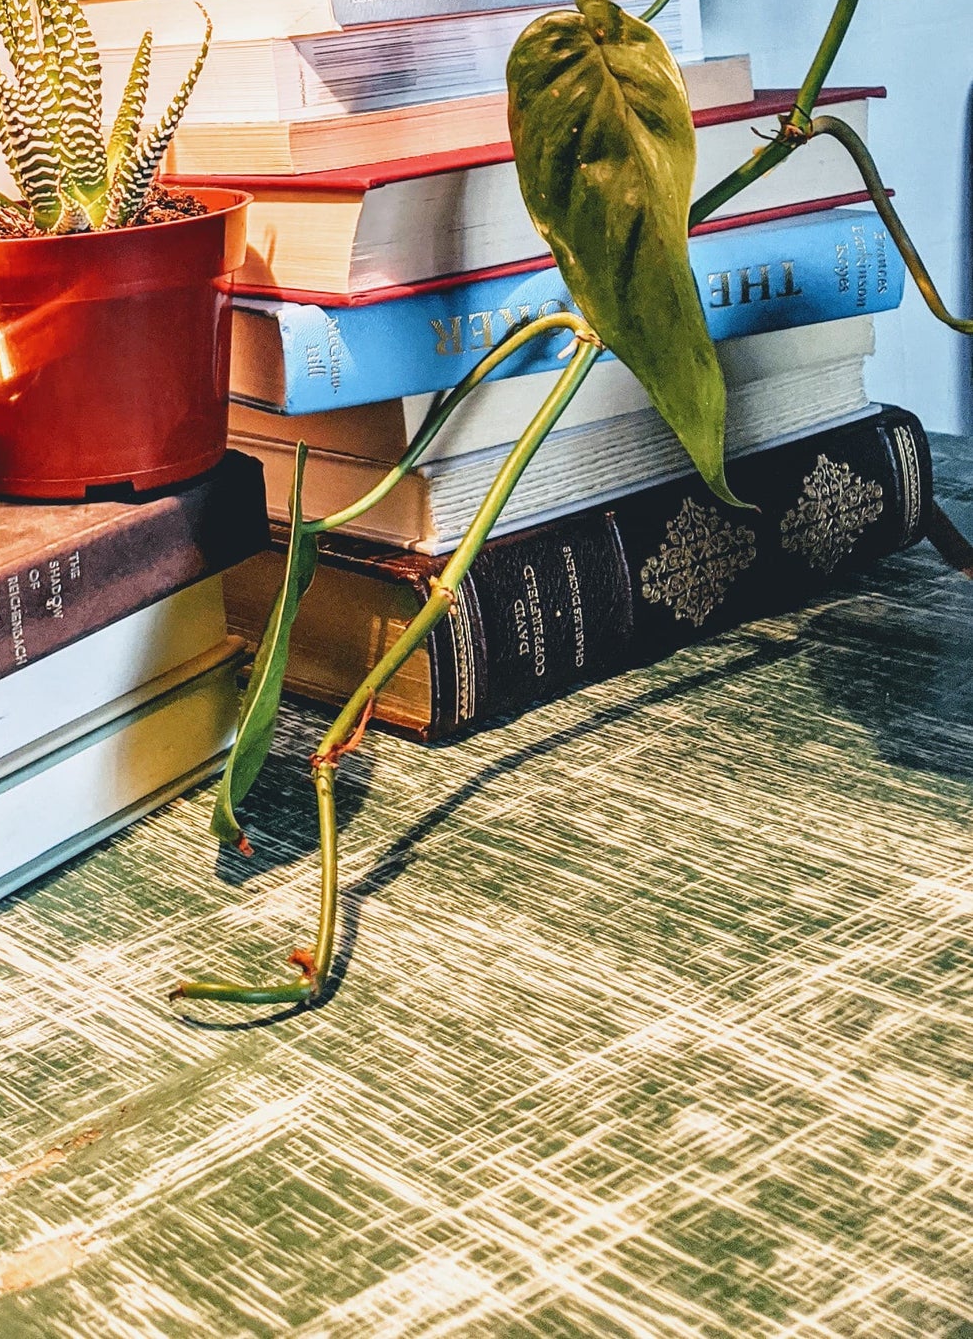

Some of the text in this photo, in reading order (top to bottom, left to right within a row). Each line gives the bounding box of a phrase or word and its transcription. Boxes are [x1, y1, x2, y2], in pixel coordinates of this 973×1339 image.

[707, 262, 803, 309] THE
[834, 242, 850, 293] Keyes
[851, 225, 873, 308] Parkinson
[873, 230, 888, 295] Frances
[28, 568, 42, 591] OF
[46, 560, 65, 619] SHADOW
[68, 551, 81, 581] THE
[6, 574, 28, 666] REICHENBACH
[513, 597, 530, 656] DAVID
[523, 563, 546, 677] COPPERFIELD
[562, 545, 585, 668] CHARLES DICKENS
